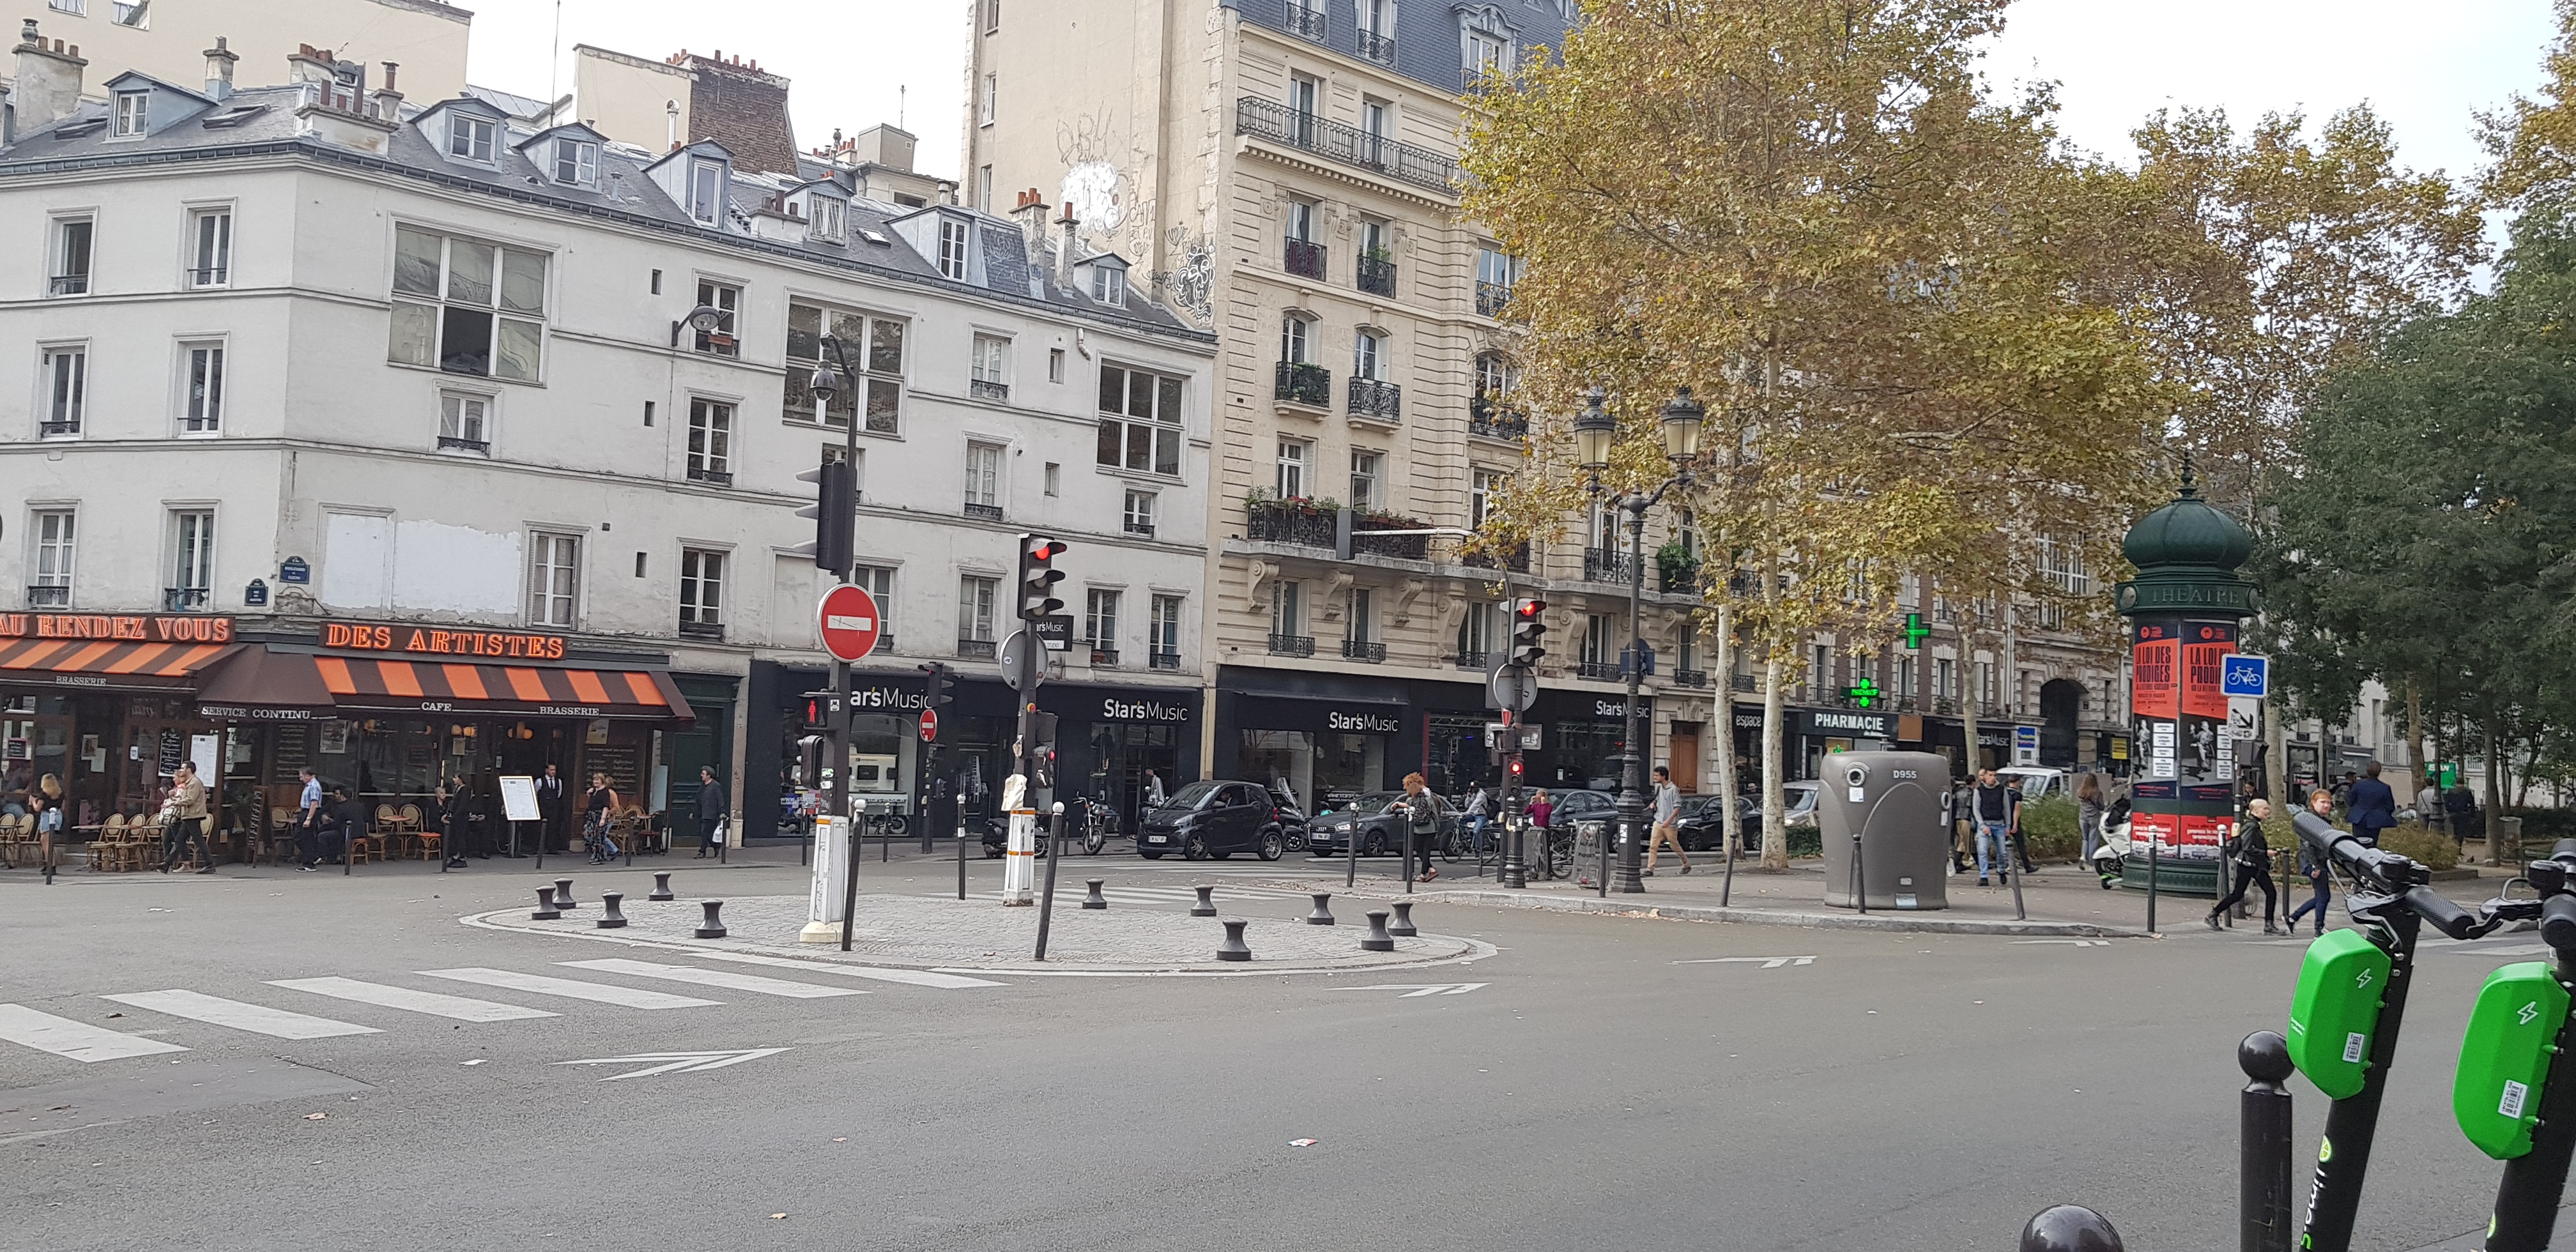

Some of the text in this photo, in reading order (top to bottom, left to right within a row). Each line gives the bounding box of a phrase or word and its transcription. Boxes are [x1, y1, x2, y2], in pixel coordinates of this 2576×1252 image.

[0, 614, 229, 641] AU RENDEZ VOUS
[326, 623, 564, 659] DES ARTISTES
[2142, 646, 2153, 664] LOI
[2156, 646, 2171, 664] DES
[2190, 647, 2200, 665] LA
[2204, 648, 2217, 666] LOI
[56, 676, 107, 686] BRASSERIE
[2191, 666, 2221, 685] PRODI
[850, 687, 933, 709] ar'sMusic
[201, 706, 310, 719] SERVICE CONTINU
[421, 702, 452, 712] CAFE
[539, 706, 600, 716] BRASSERIE
[1596, 700, 1650, 718] Star'sMsic
[1736, 715, 1762, 728] espace
[1815, 713, 1884, 730] PHARMACIE
[1893, 770, 1917, 779] D955
